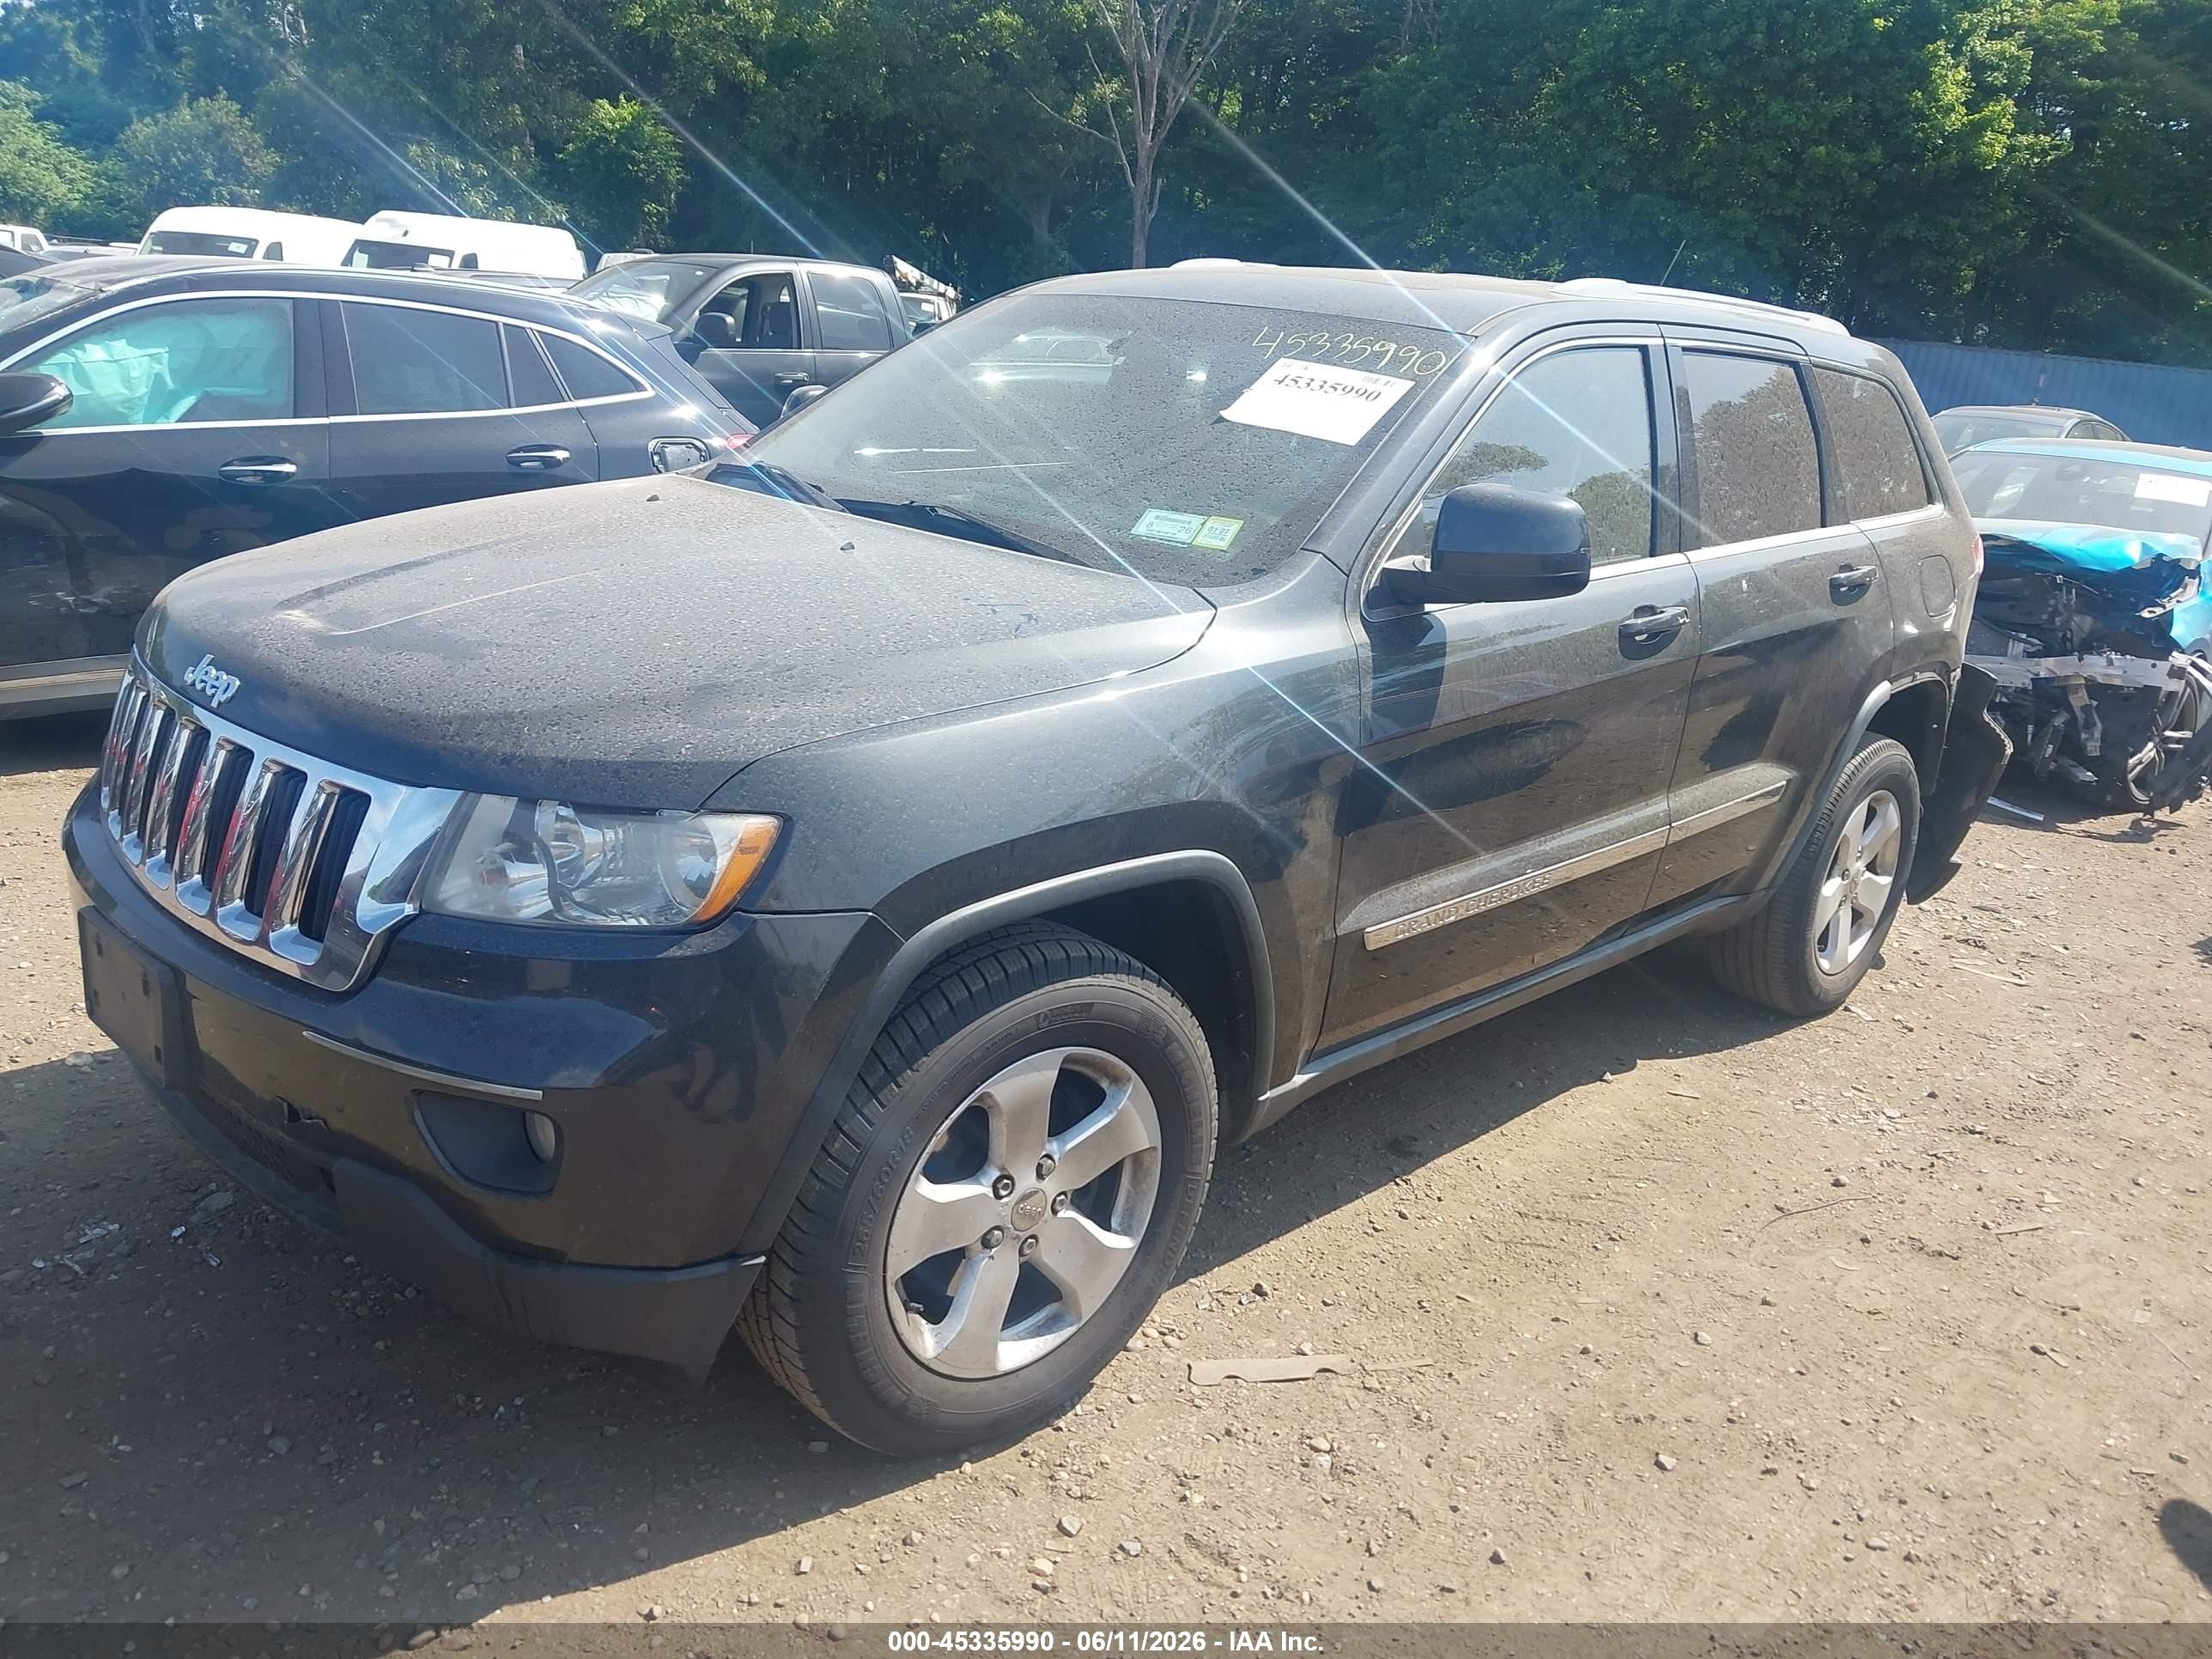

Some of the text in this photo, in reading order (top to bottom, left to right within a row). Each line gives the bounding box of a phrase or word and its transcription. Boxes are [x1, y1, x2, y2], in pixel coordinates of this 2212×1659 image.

[1252, 326, 1446, 375] 45335990
[1273, 374, 1382, 402] 45335990
[1176, 526, 1194, 534] 26
[184, 653, 240, 708] Jeep
[1395, 873, 1553, 939] GRAND CHEROKEE
